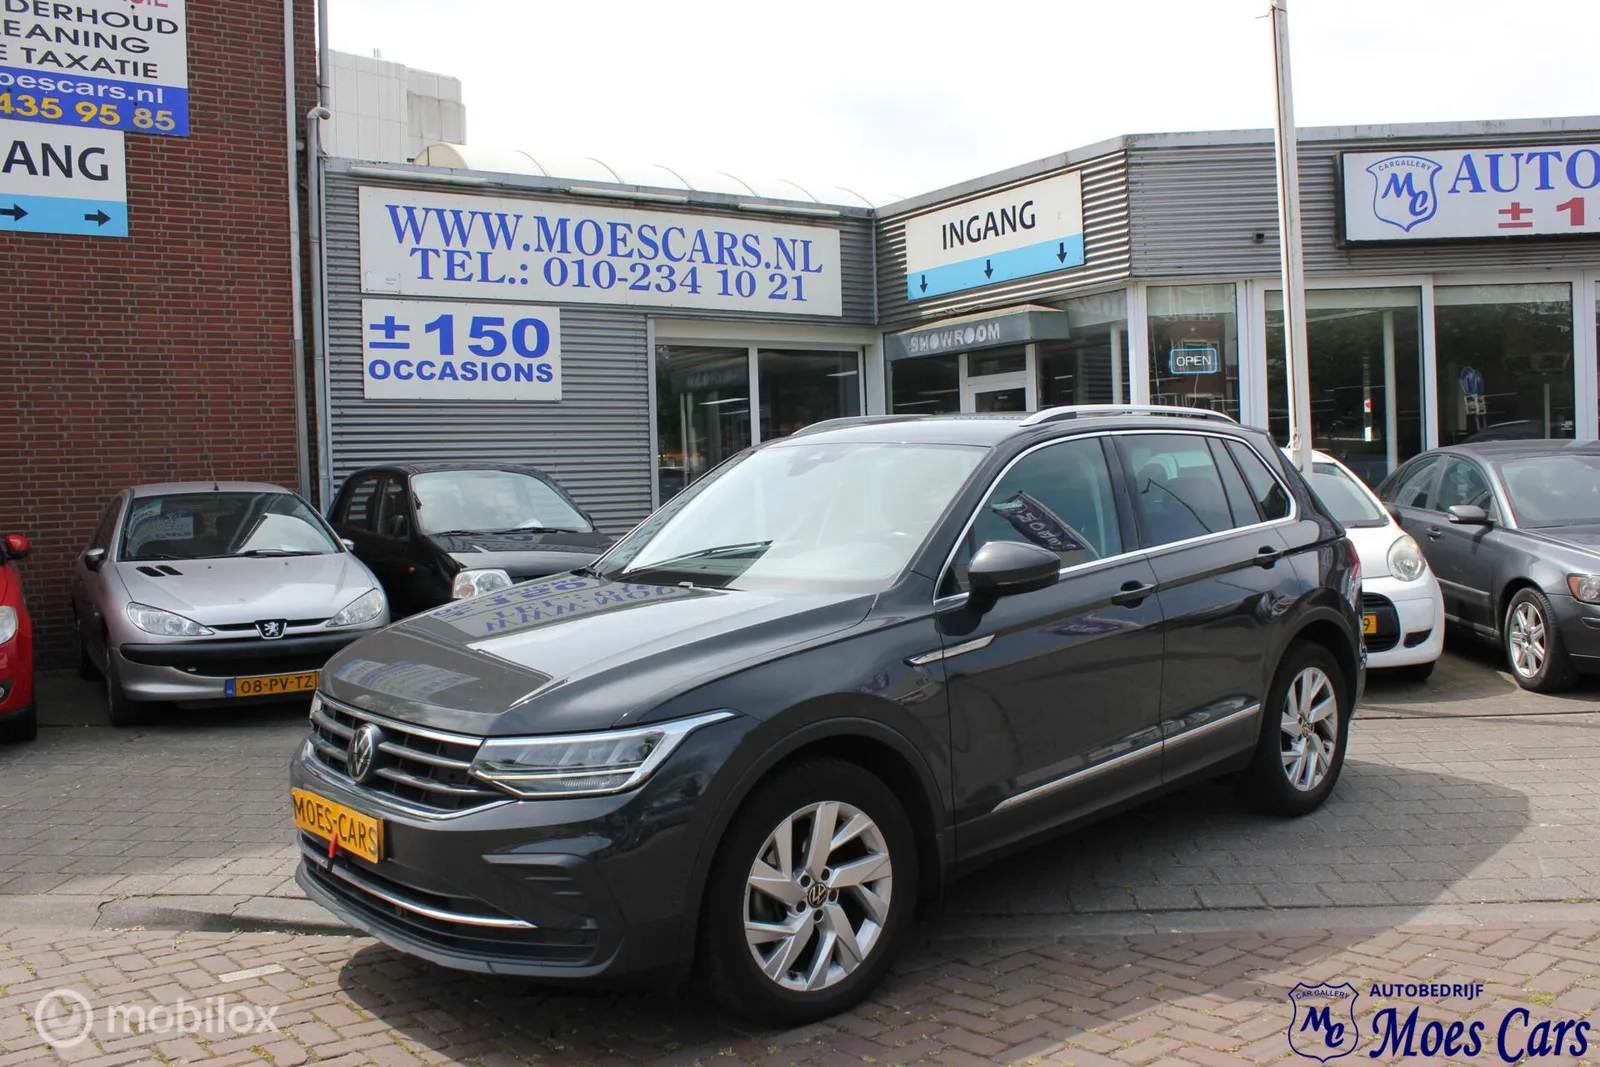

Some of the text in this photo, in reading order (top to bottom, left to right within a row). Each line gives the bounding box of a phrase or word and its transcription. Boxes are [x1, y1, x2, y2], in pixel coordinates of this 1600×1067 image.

[5, 0, 179, 35] DERHOUD
[0, 19, 150, 54] EANING
[20, 46, 158, 79] TAXATIE
[75, 101, 121, 125] 95
[132, 107, 176, 131] 85
[2, 140, 109, 181] ANG
[1447, 149, 1600, 194] AUTO
[385, 204, 823, 274] WWW.MOESCARS.NL
[942, 200, 1036, 250] INGANG
[409, 247, 807, 302] TEL.: 010-234 10 21
[910, 322, 1000, 352] SHOWROOM
[368, 359, 553, 383] OCCASIONS
[1176, 355, 1212, 367] OPEN
[241, 675, 313, 694] 08-PV-TZ
[292, 794, 378, 855] MOES-CARS
